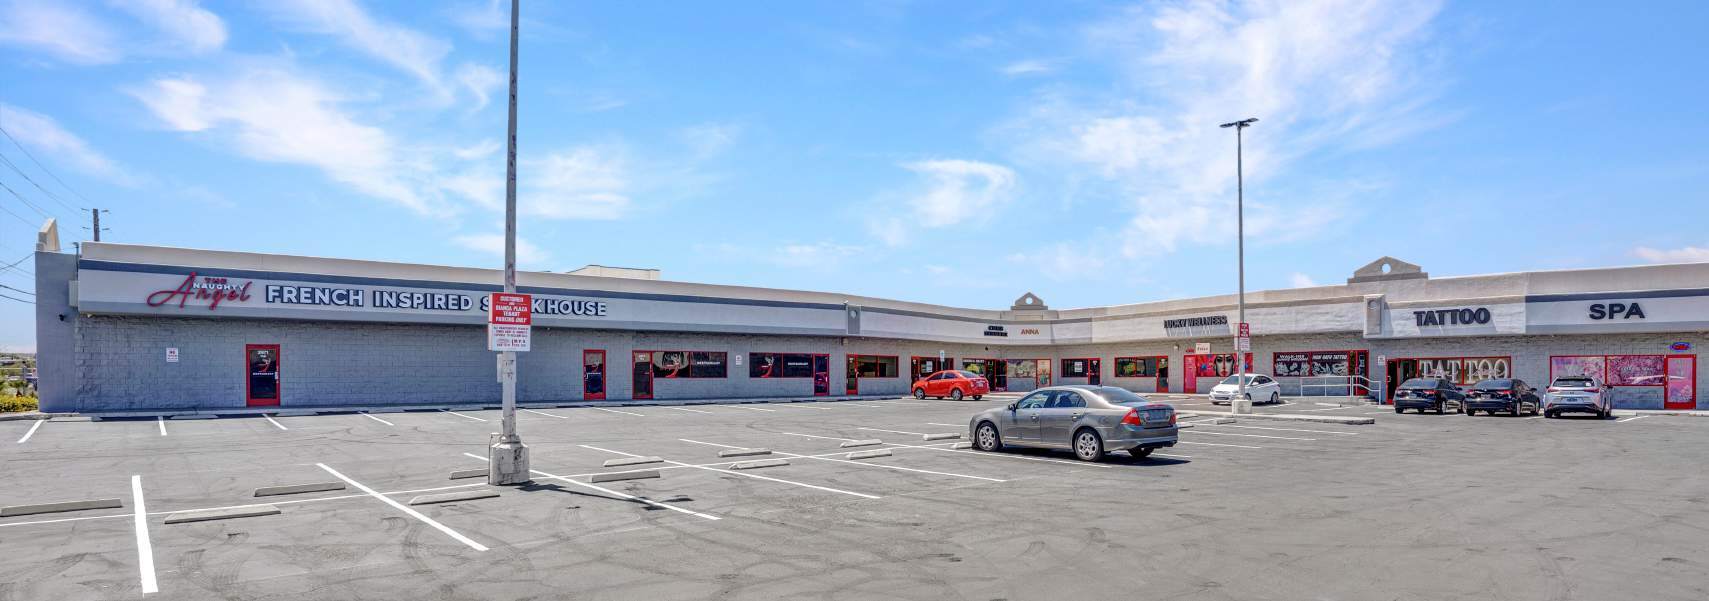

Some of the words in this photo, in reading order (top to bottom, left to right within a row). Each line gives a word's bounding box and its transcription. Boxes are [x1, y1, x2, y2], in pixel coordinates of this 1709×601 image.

[146, 271, 253, 310] Angel
[193, 282, 244, 290] NAUGHTY
[265, 284, 364, 307] FRENCH
[374, 289, 473, 311] INSPIRED
[480, 296, 607, 316] SKHOUSE
[1413, 307, 1491, 327] TATTOO
[1589, 302, 1645, 320] SPA
[1163, 318, 1187, 329] LUCKY
[1187, 315, 1228, 327] WELLNESS
[1421, 359, 1508, 384] TATTOO
